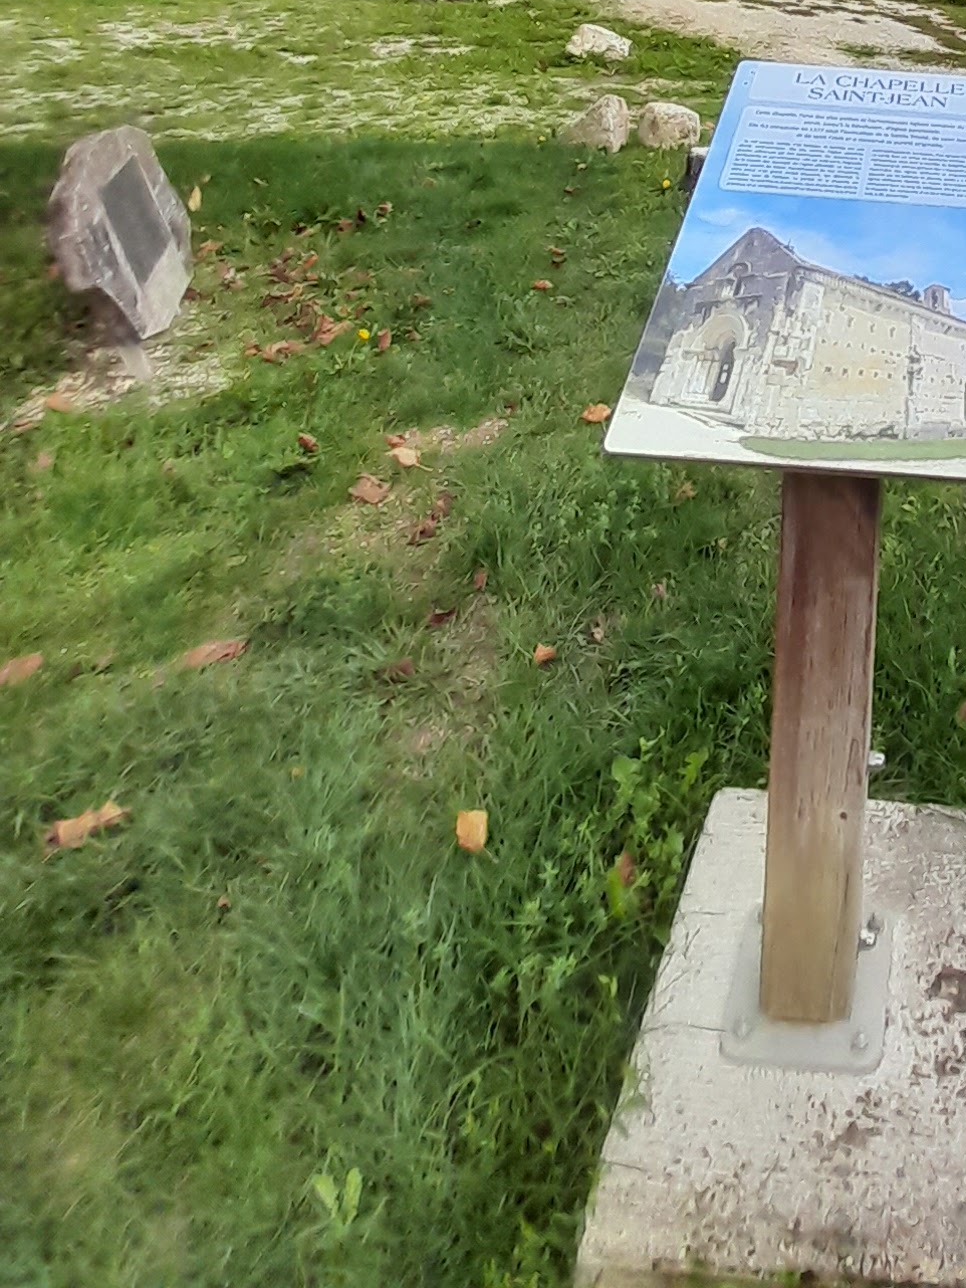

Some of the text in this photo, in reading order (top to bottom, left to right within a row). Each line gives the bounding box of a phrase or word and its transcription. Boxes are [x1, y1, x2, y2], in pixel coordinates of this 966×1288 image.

[795, 72, 965, 96] LA CHAPELLE
[807, 87, 948, 109] SAINT-JEAN
